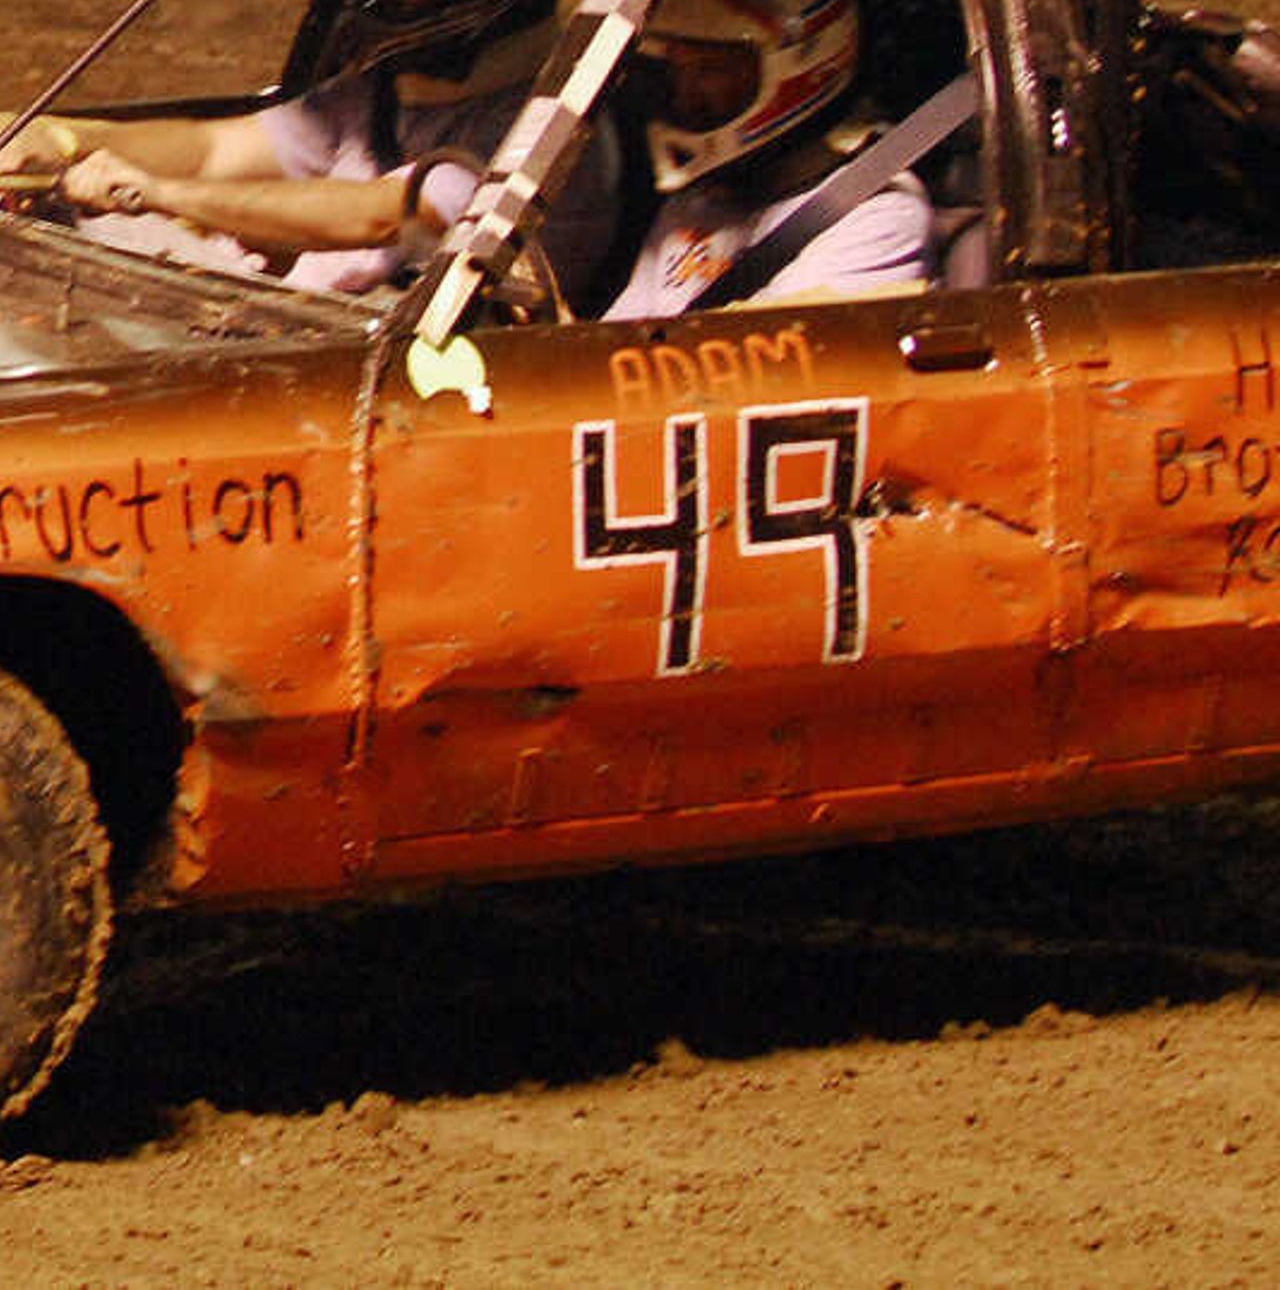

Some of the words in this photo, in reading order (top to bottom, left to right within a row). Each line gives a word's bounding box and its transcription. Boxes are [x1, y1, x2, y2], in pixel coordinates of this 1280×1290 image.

[609, 328, 818, 408] ADAM
[1153, 425, 1280, 507] Bro
[571, 396, 870, 678] 49
